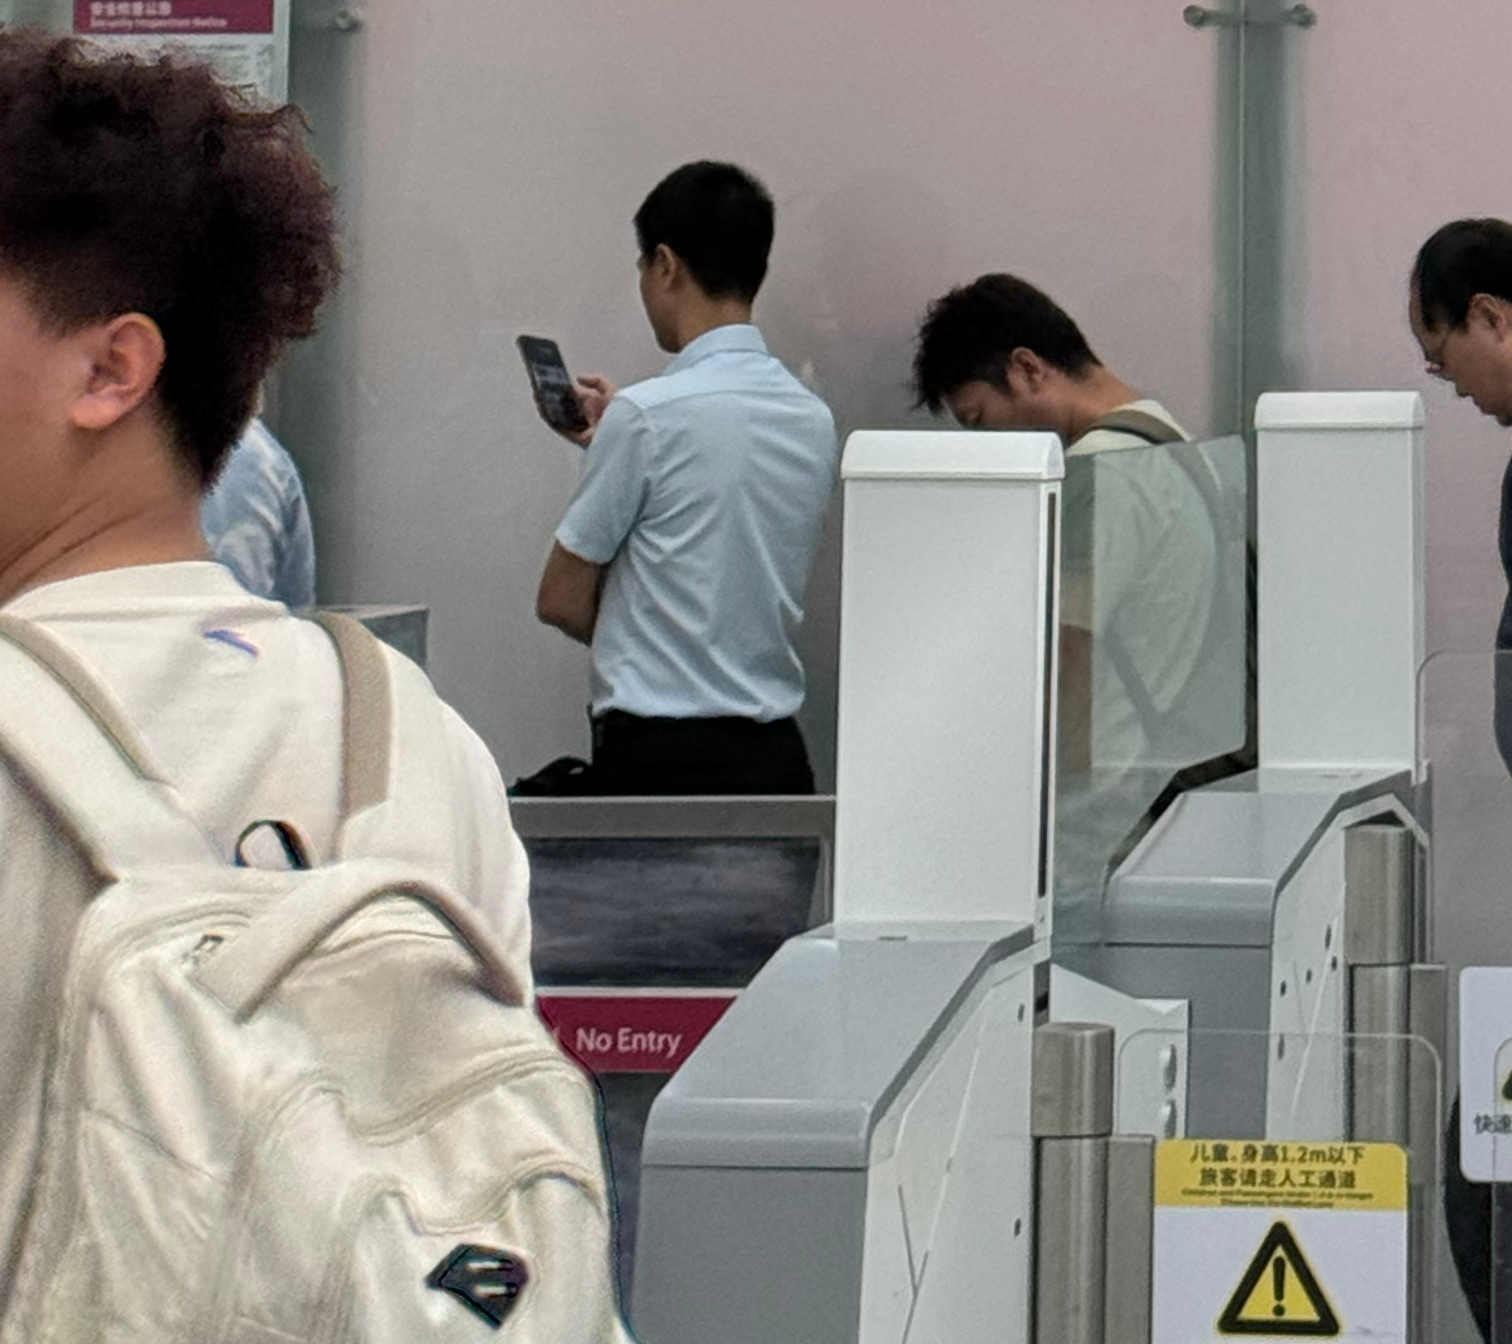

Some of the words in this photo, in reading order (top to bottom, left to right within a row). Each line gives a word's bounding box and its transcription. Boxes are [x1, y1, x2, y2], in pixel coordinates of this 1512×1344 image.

[576, 1027, 612, 1053] No
[617, 1027, 682, 1059] Entry
[1199, 1167, 1357, 1190] 旅客请走人工通道
